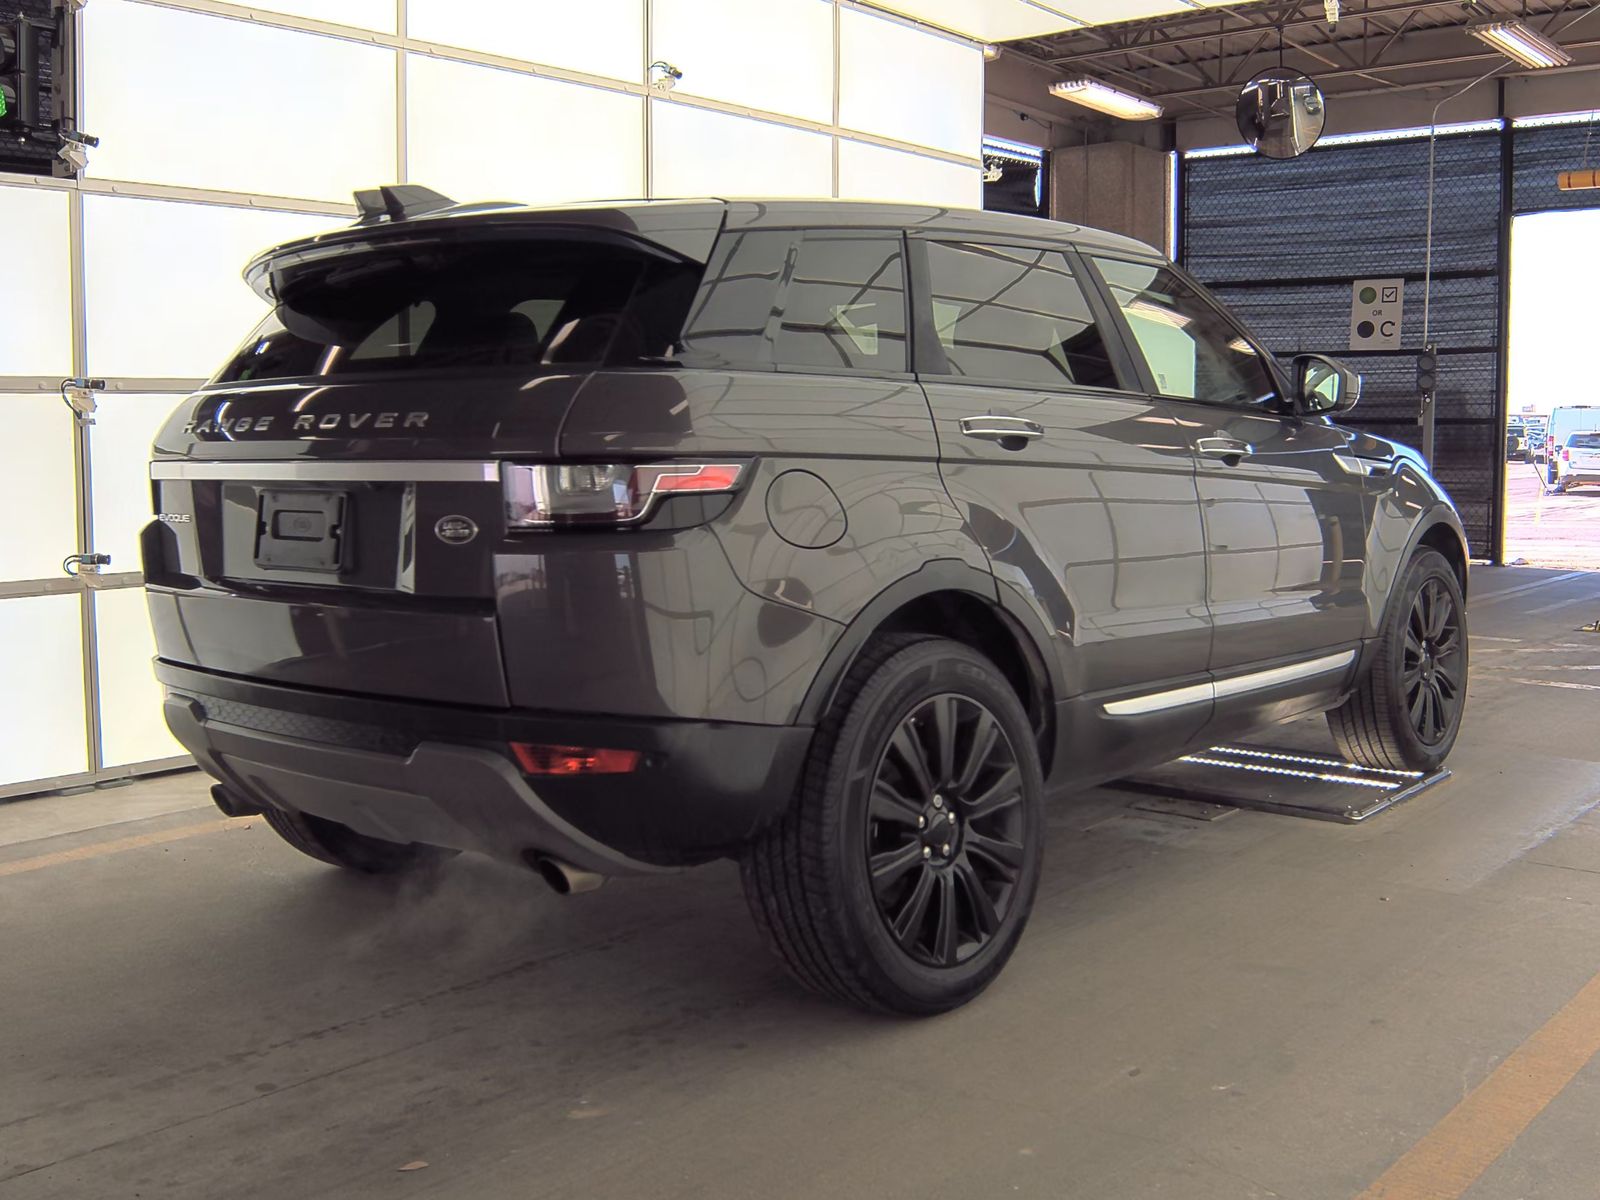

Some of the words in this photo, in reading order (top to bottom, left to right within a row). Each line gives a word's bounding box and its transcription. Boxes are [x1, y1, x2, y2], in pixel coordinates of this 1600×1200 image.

[1372, 309, 1383, 317] OR
[182, 416, 275, 434] RANGE
[292, 411, 430, 430] ROVER
